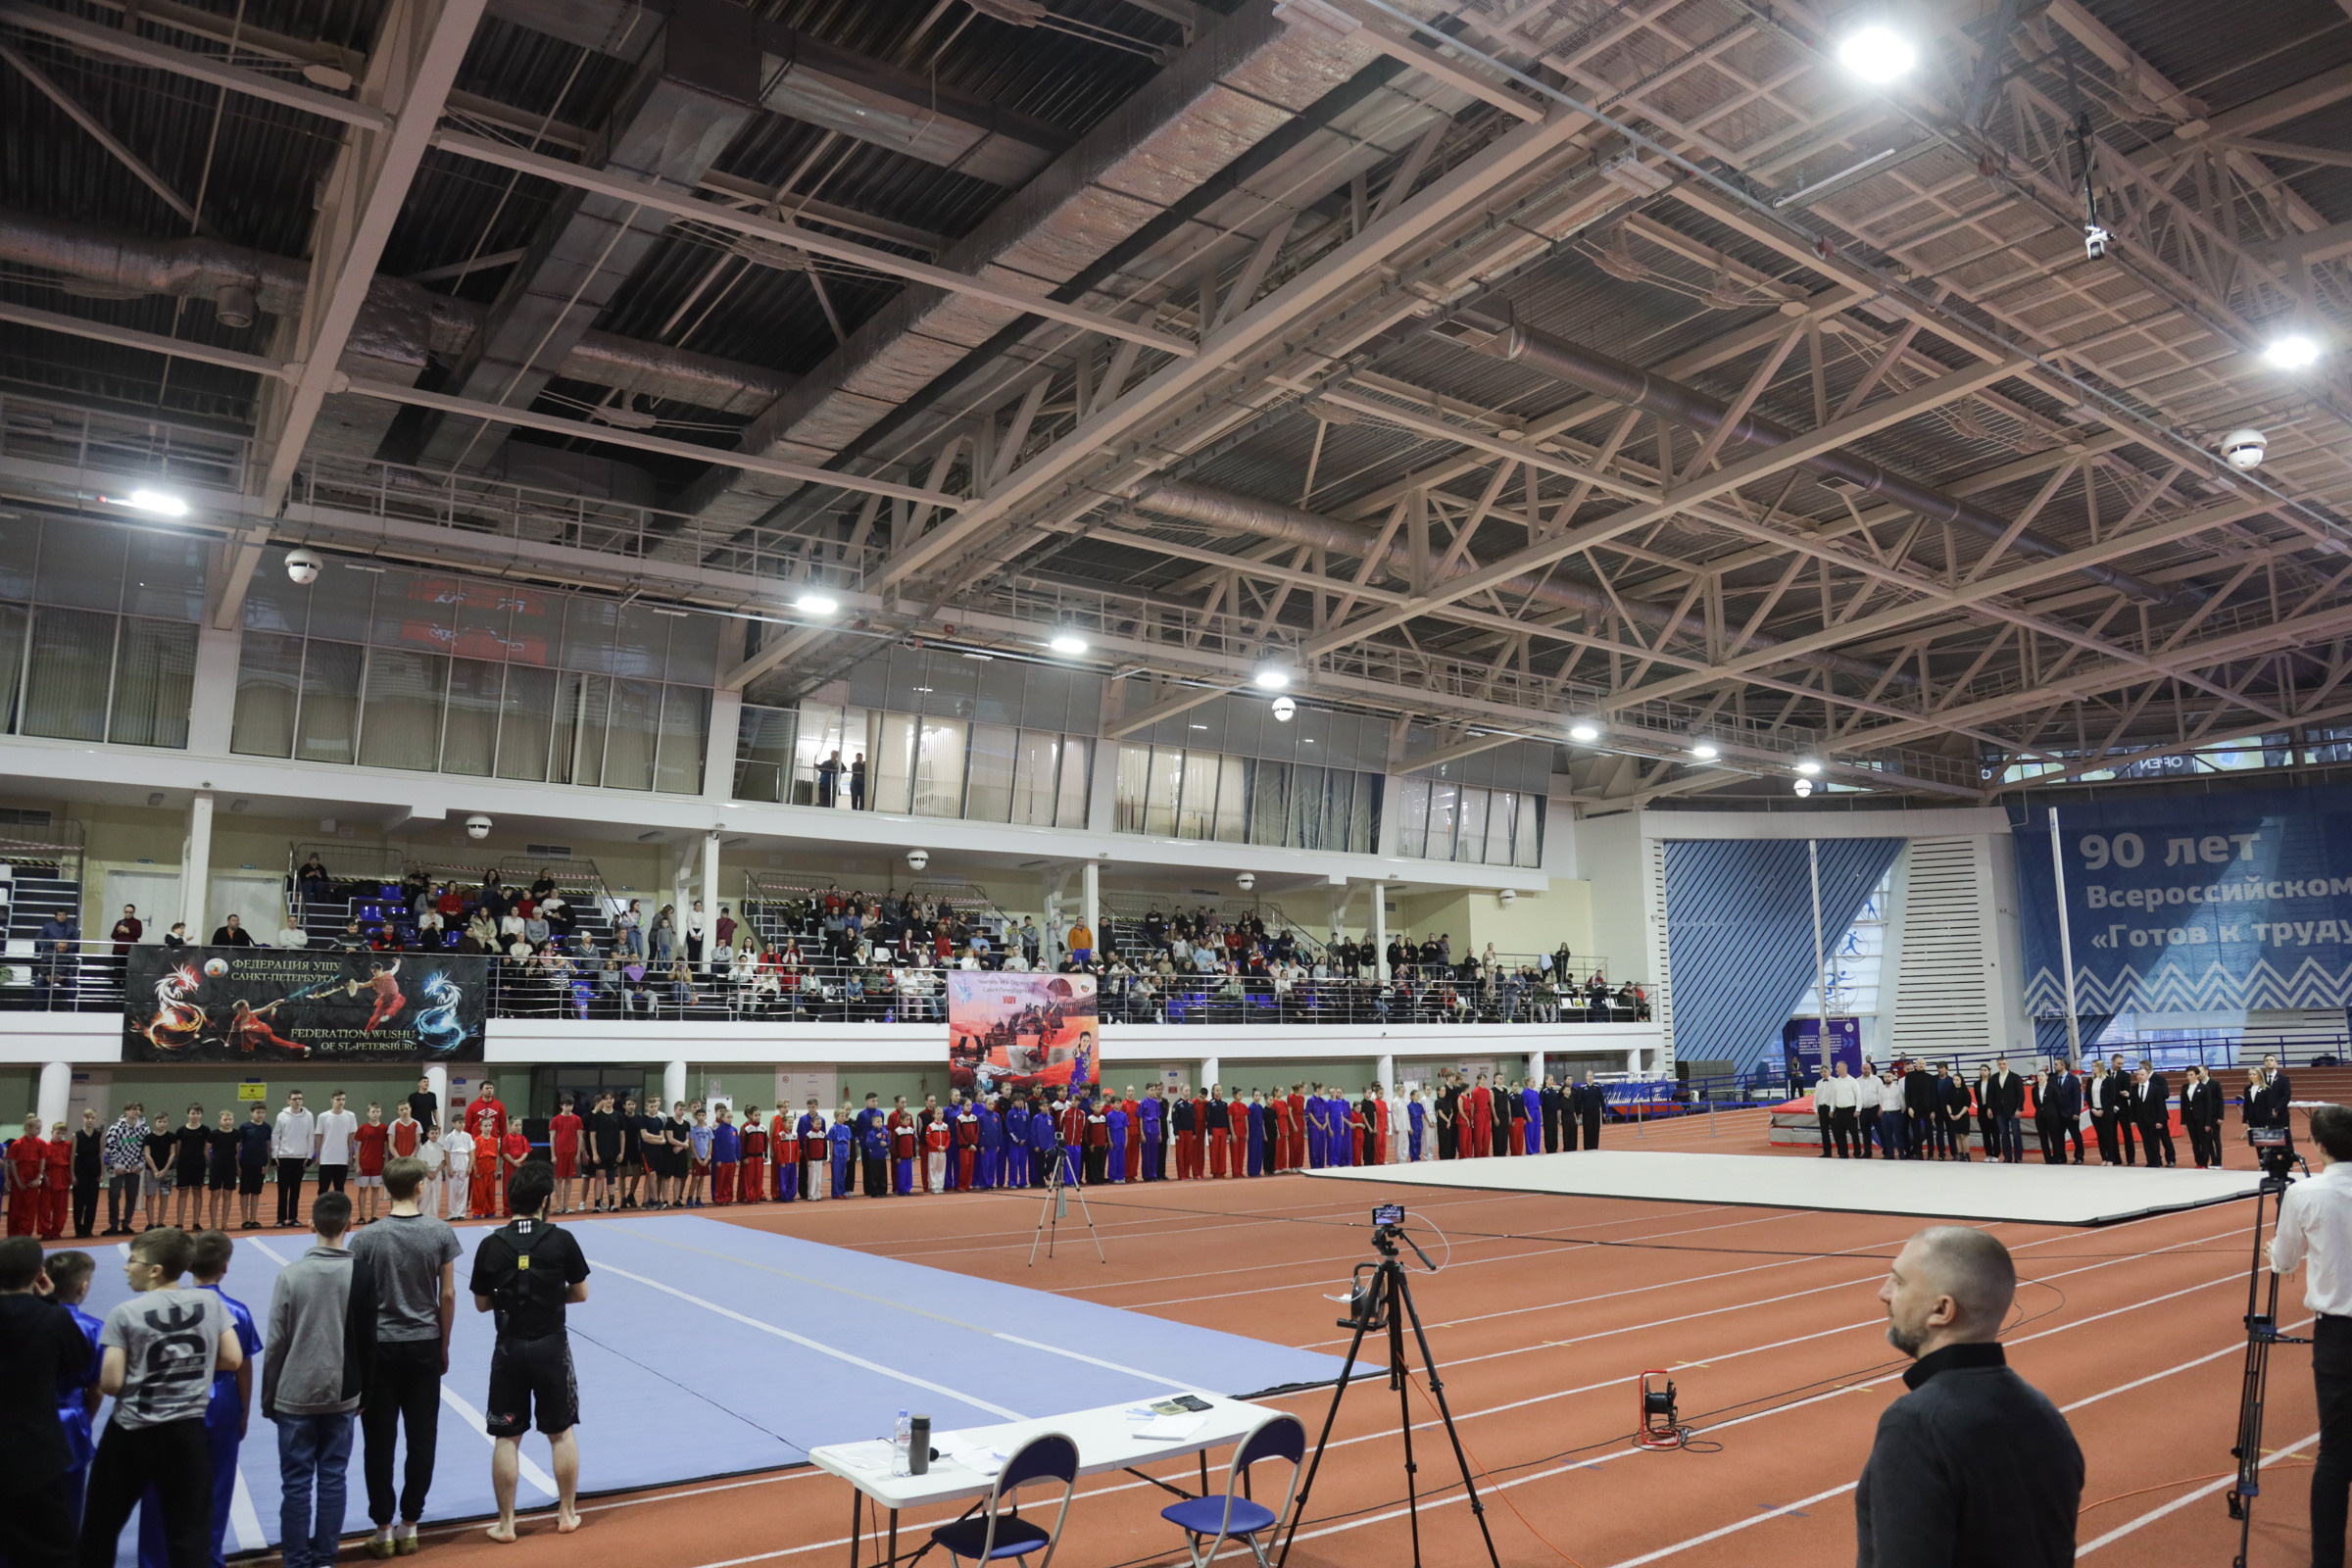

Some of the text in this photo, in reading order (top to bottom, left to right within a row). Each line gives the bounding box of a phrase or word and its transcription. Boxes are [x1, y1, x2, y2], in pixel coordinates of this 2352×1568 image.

[2080, 832, 2261, 869] 90 лет
[2086, 874, 2352, 912] Всероссийском
[2091, 924, 2208, 949] «Готов
[2220, 924, 2241, 943] к
[231, 959, 341, 971] ФЕДЕРАЦИЯ УШУ
[231, 972, 336, 982] САНКТ-ПЕТЕРБУРГА
[290, 1028, 416, 1039] FEDERATION WUSHU
[320, 1042, 335, 1051] OF
